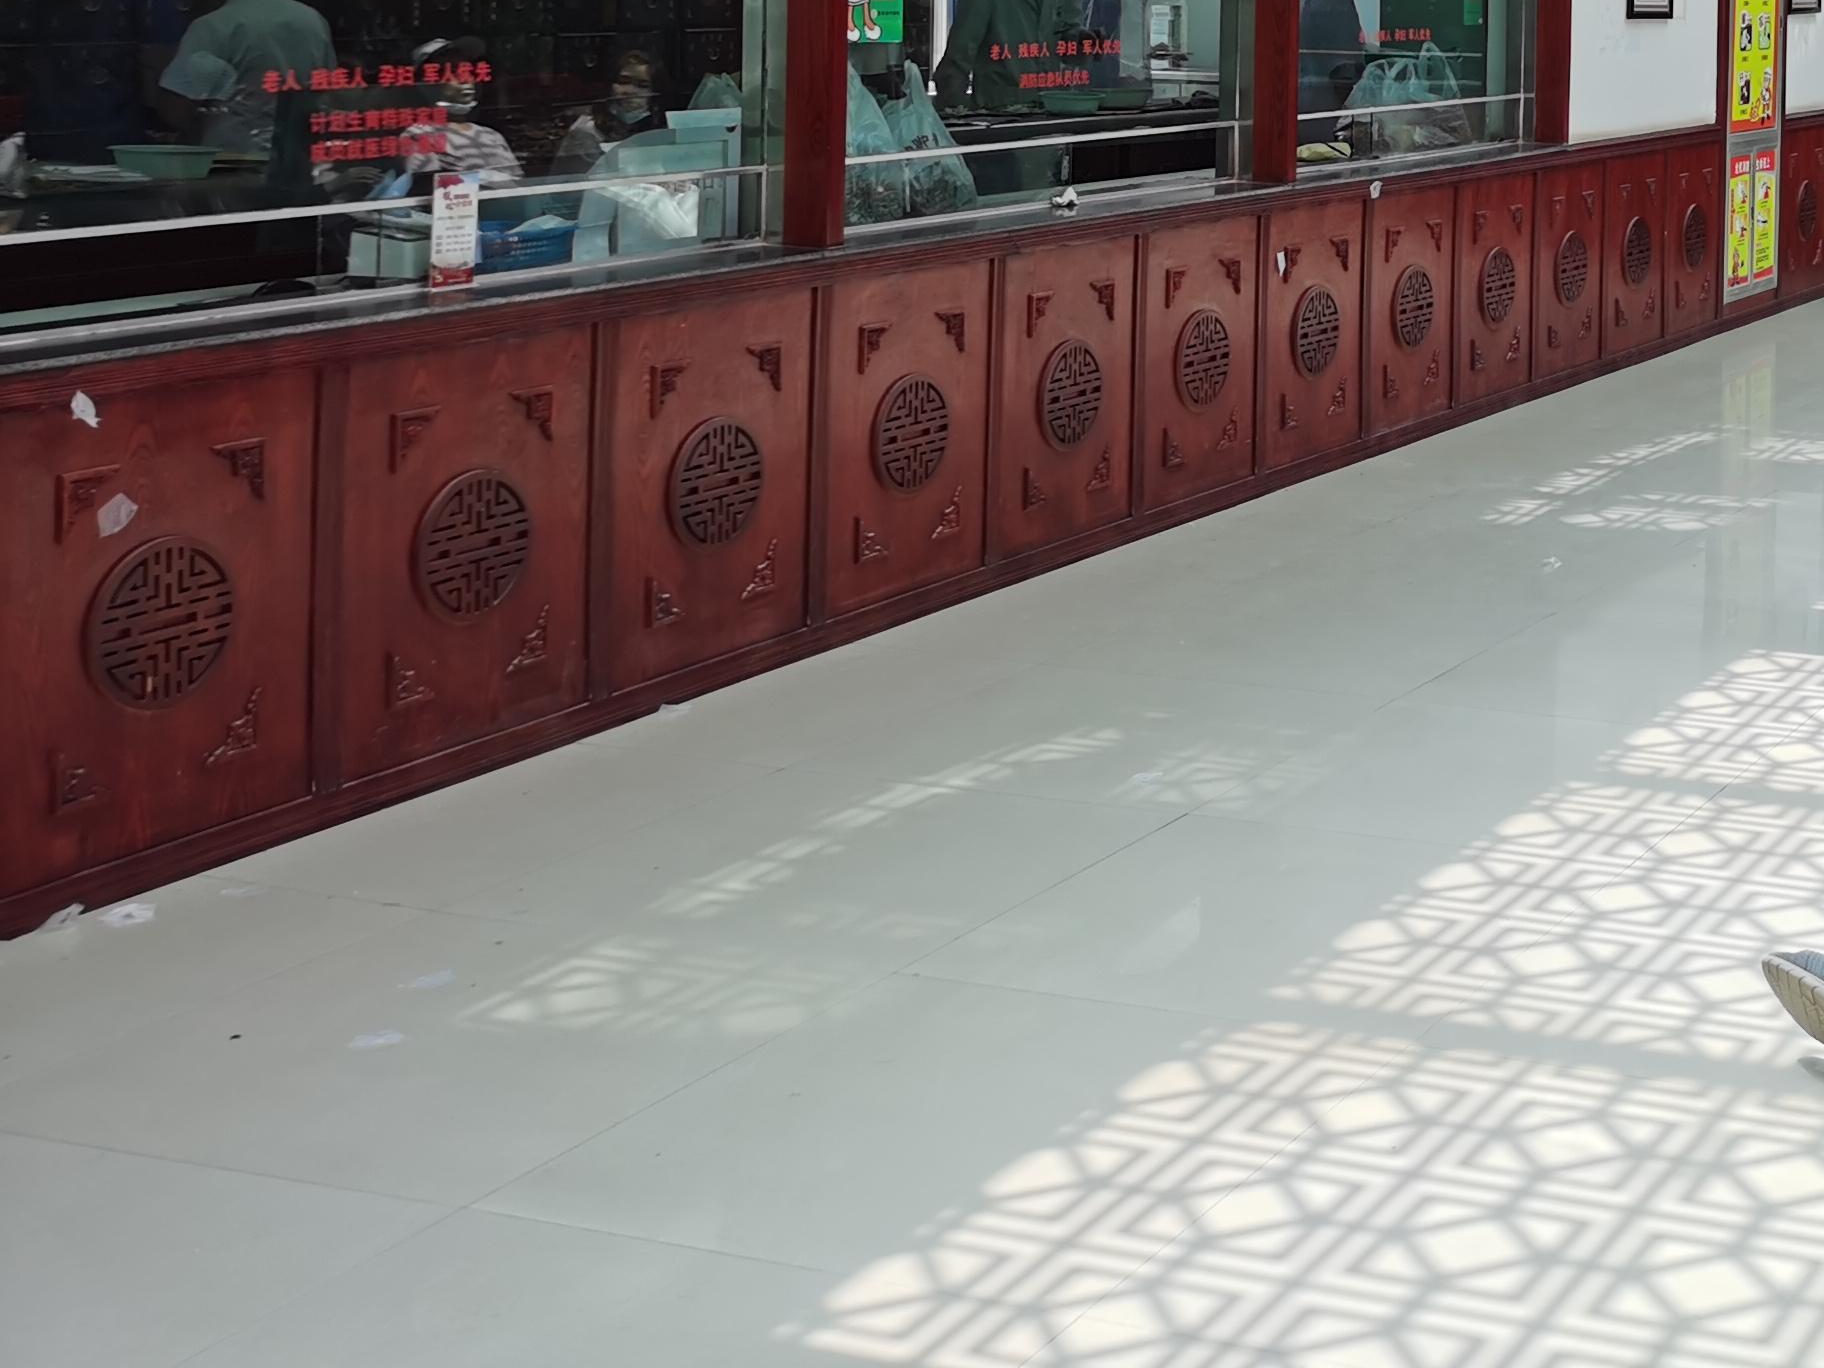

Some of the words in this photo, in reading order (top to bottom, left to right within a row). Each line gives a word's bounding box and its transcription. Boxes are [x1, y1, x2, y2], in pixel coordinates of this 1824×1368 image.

[990, 43, 1011, 60] 老人
[262, 70, 302, 93] 老人
[310, 66, 368, 91] 残疾人
[378, 64, 415, 87] 孕妇
[422, 61, 492, 84] 军人优先
